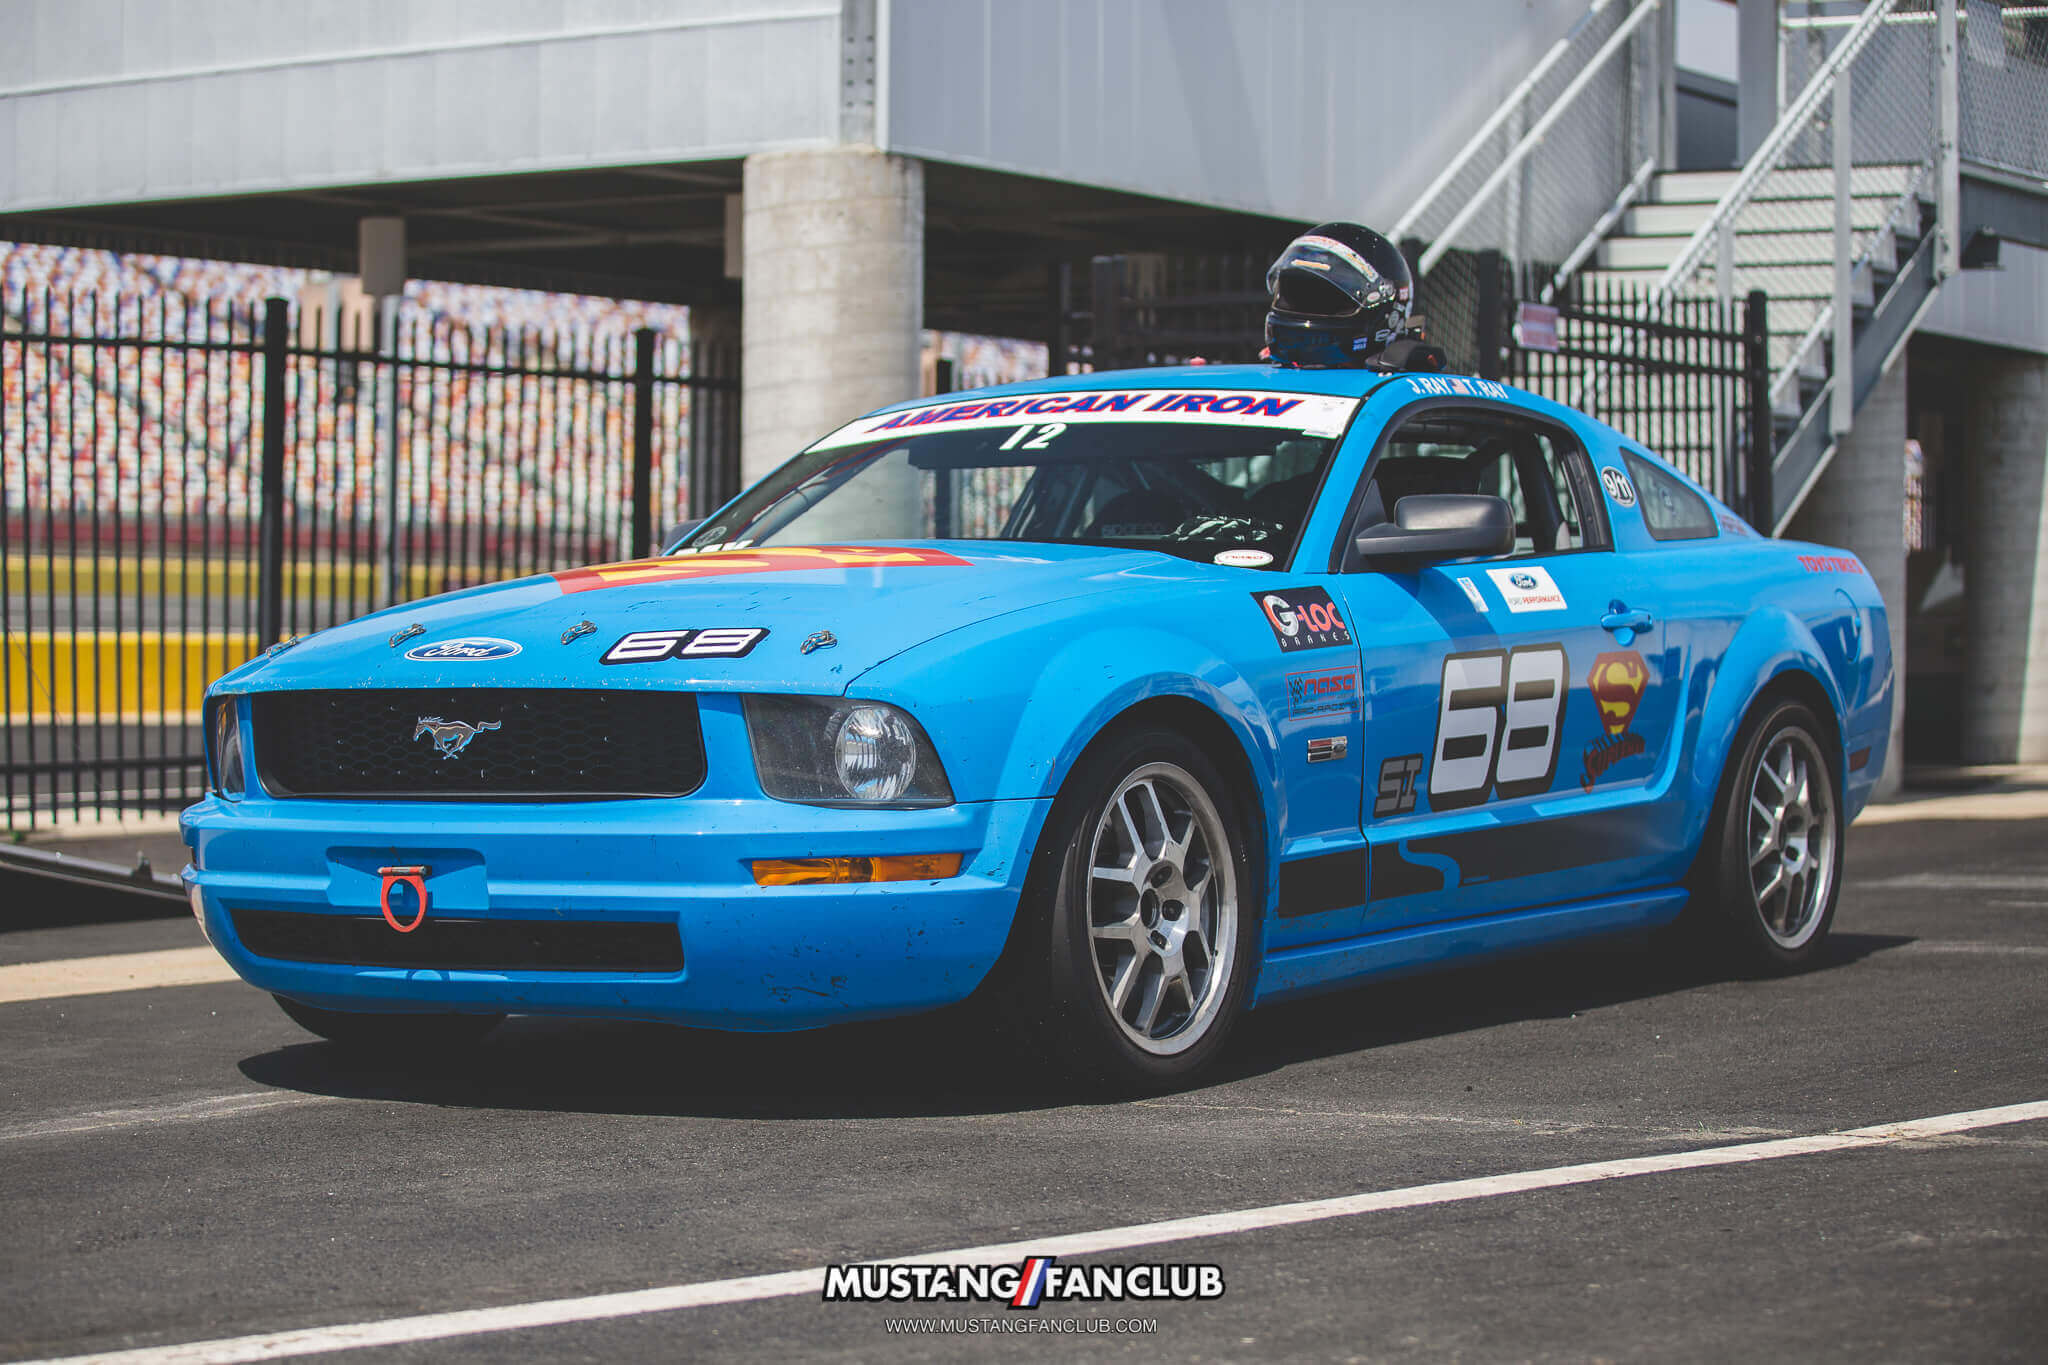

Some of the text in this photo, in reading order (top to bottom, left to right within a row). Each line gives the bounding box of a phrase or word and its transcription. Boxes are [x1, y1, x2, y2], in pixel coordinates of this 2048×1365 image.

[864, 393, 1305, 433] AMERICAN IRON
[999, 423, 1067, 450] 12
[1263, 595, 1346, 637] G-LOC
[423, 638, 500, 658] Ford
[602, 628, 768, 664] 68
[1281, 630, 1350, 648] BRAKES
[1429, 646, 1567, 809] 68
